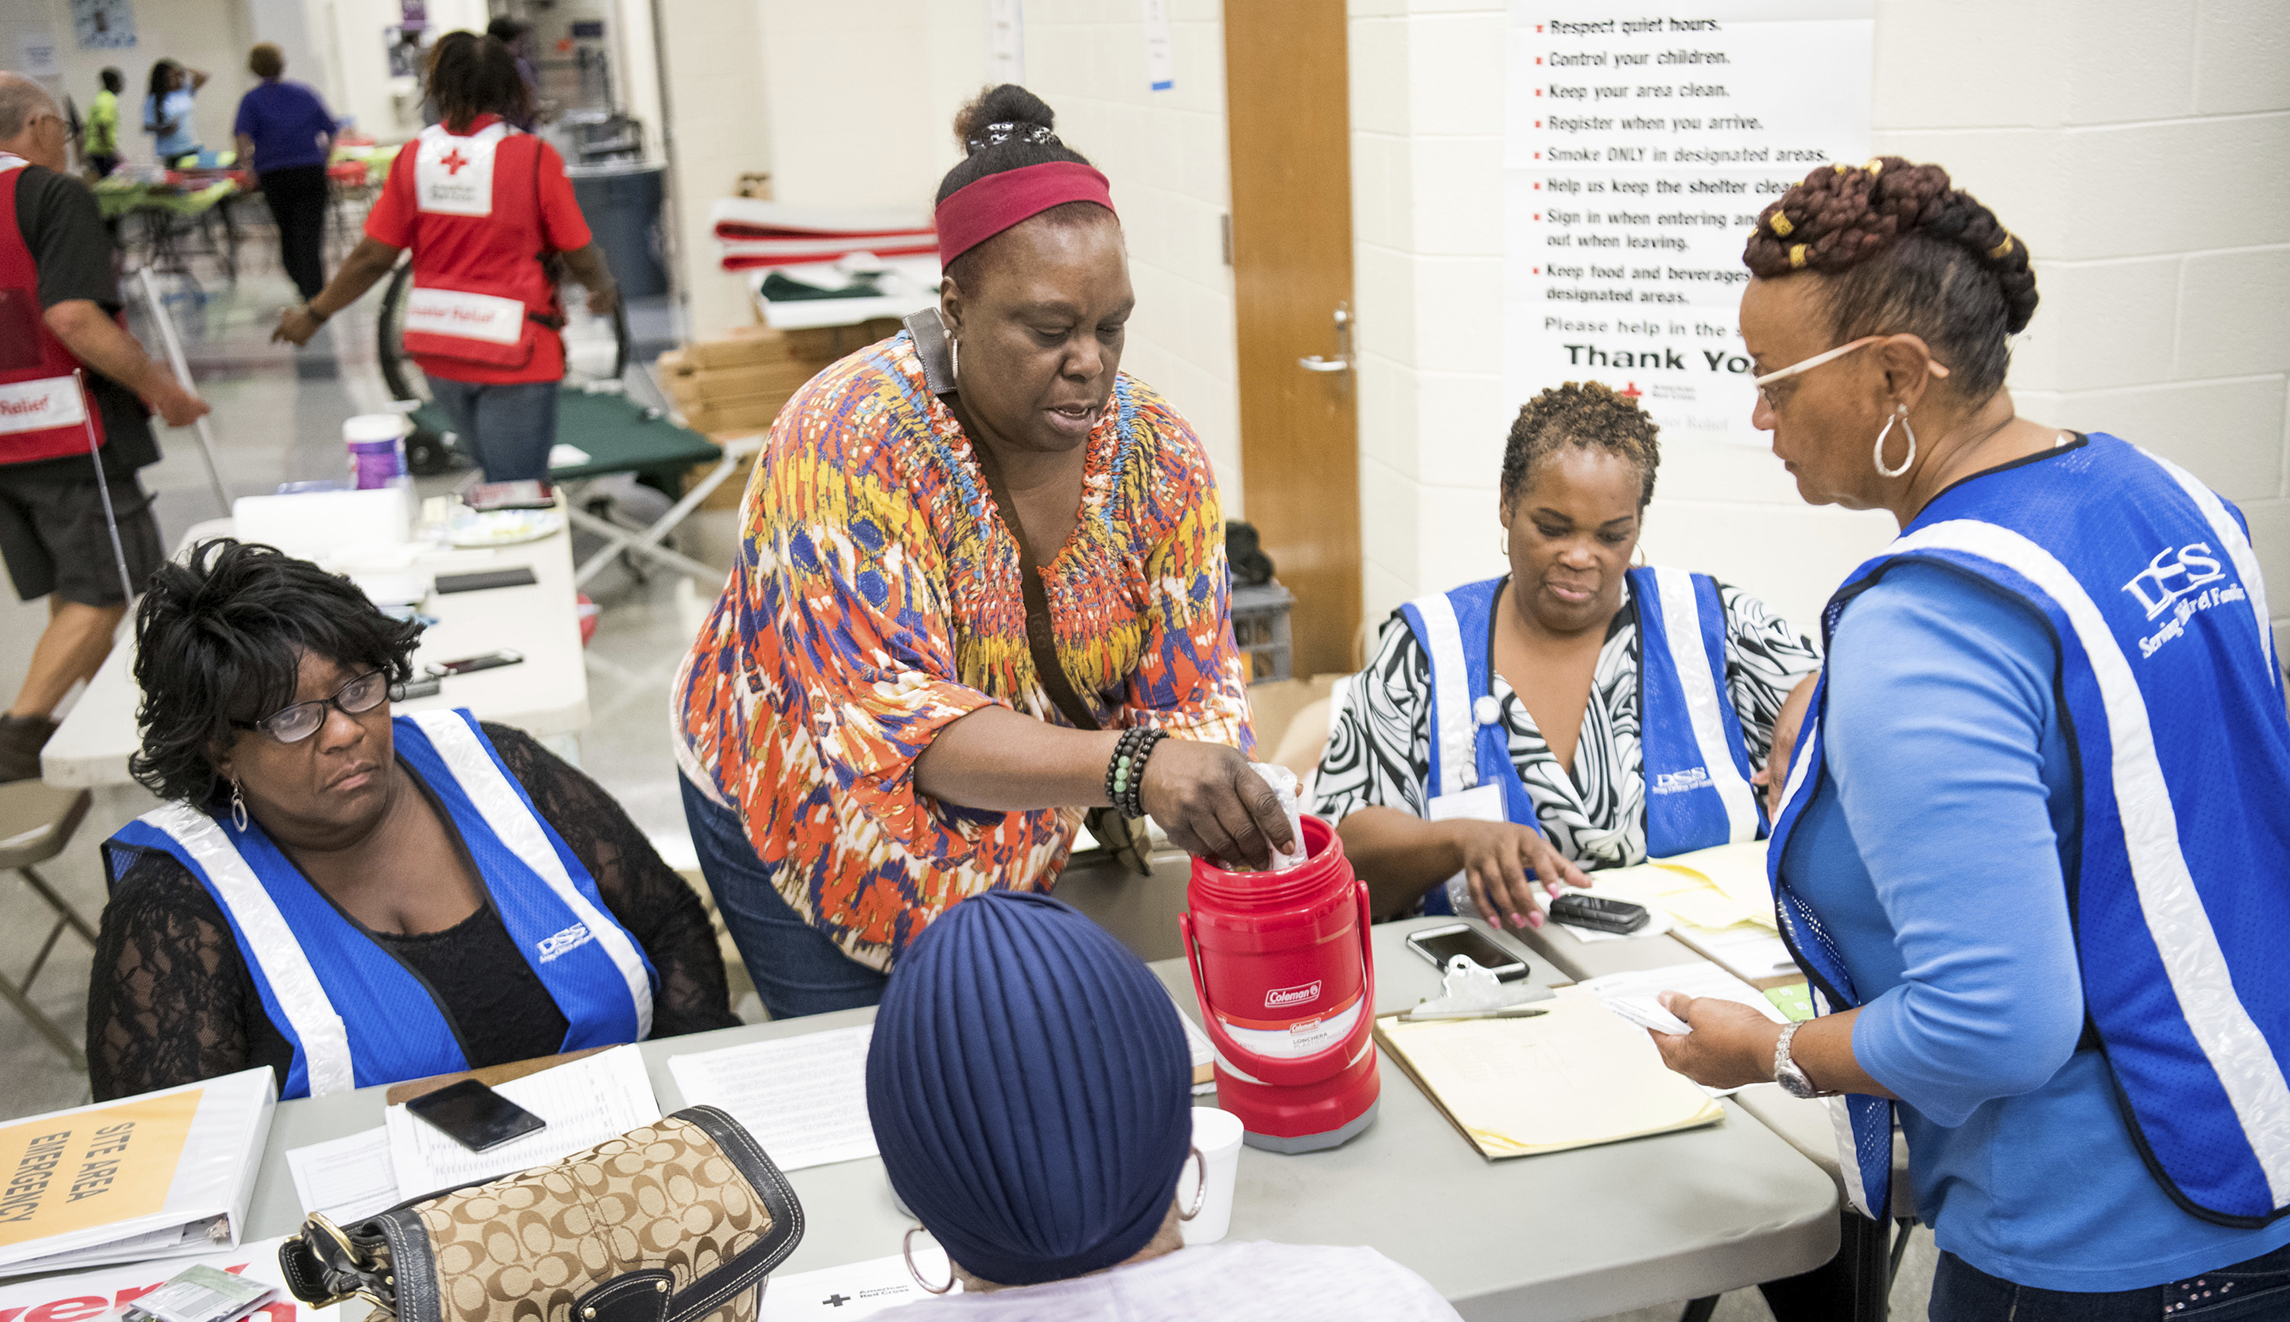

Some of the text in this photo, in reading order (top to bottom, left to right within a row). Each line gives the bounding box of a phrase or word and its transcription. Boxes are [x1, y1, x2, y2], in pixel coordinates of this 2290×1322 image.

[1551, 18, 1721, 36] Respect quiet hours.
[1550, 50, 1730, 68] Control your children.
[1550, 83, 1729, 101] Keep your area clean.
[1549, 114, 1763, 133] Register when you arrive.
[1548, 147, 1829, 165] Smoke ONLY in designated areas.
[1548, 179, 1790, 196] Help us keep the shelter clea
[1547, 209, 1580, 227] Sign
[1587, 210, 1601, 224] in
[1608, 211, 1650, 224] when
[1657, 211, 1727, 229] entering
[1547, 234, 1689, 252] out when leaving.
[1547, 264, 1750, 285] Keep food and beverages
[1546, 287, 1689, 304] designated areas.
[1545, 317, 1608, 332] Please
[1618, 320, 1660, 337] help
[1669, 321, 1686, 335] in
[1695, 323, 1726, 337] the
[1564, 345, 1750, 373] Thank Yo
[0, 393, 49, 415] Relief
[2121, 541, 2226, 622] DSS
[1657, 767, 1706, 787] DSS
[537, 922, 587, 955] DSS
[1270, 989, 1310, 1003] Coleman
[1293, 1032, 1328, 1044] LONCHERA
[65, 1121, 136, 1204] SITE AREA
[0, 1130, 72, 1223] EMERGENCY
